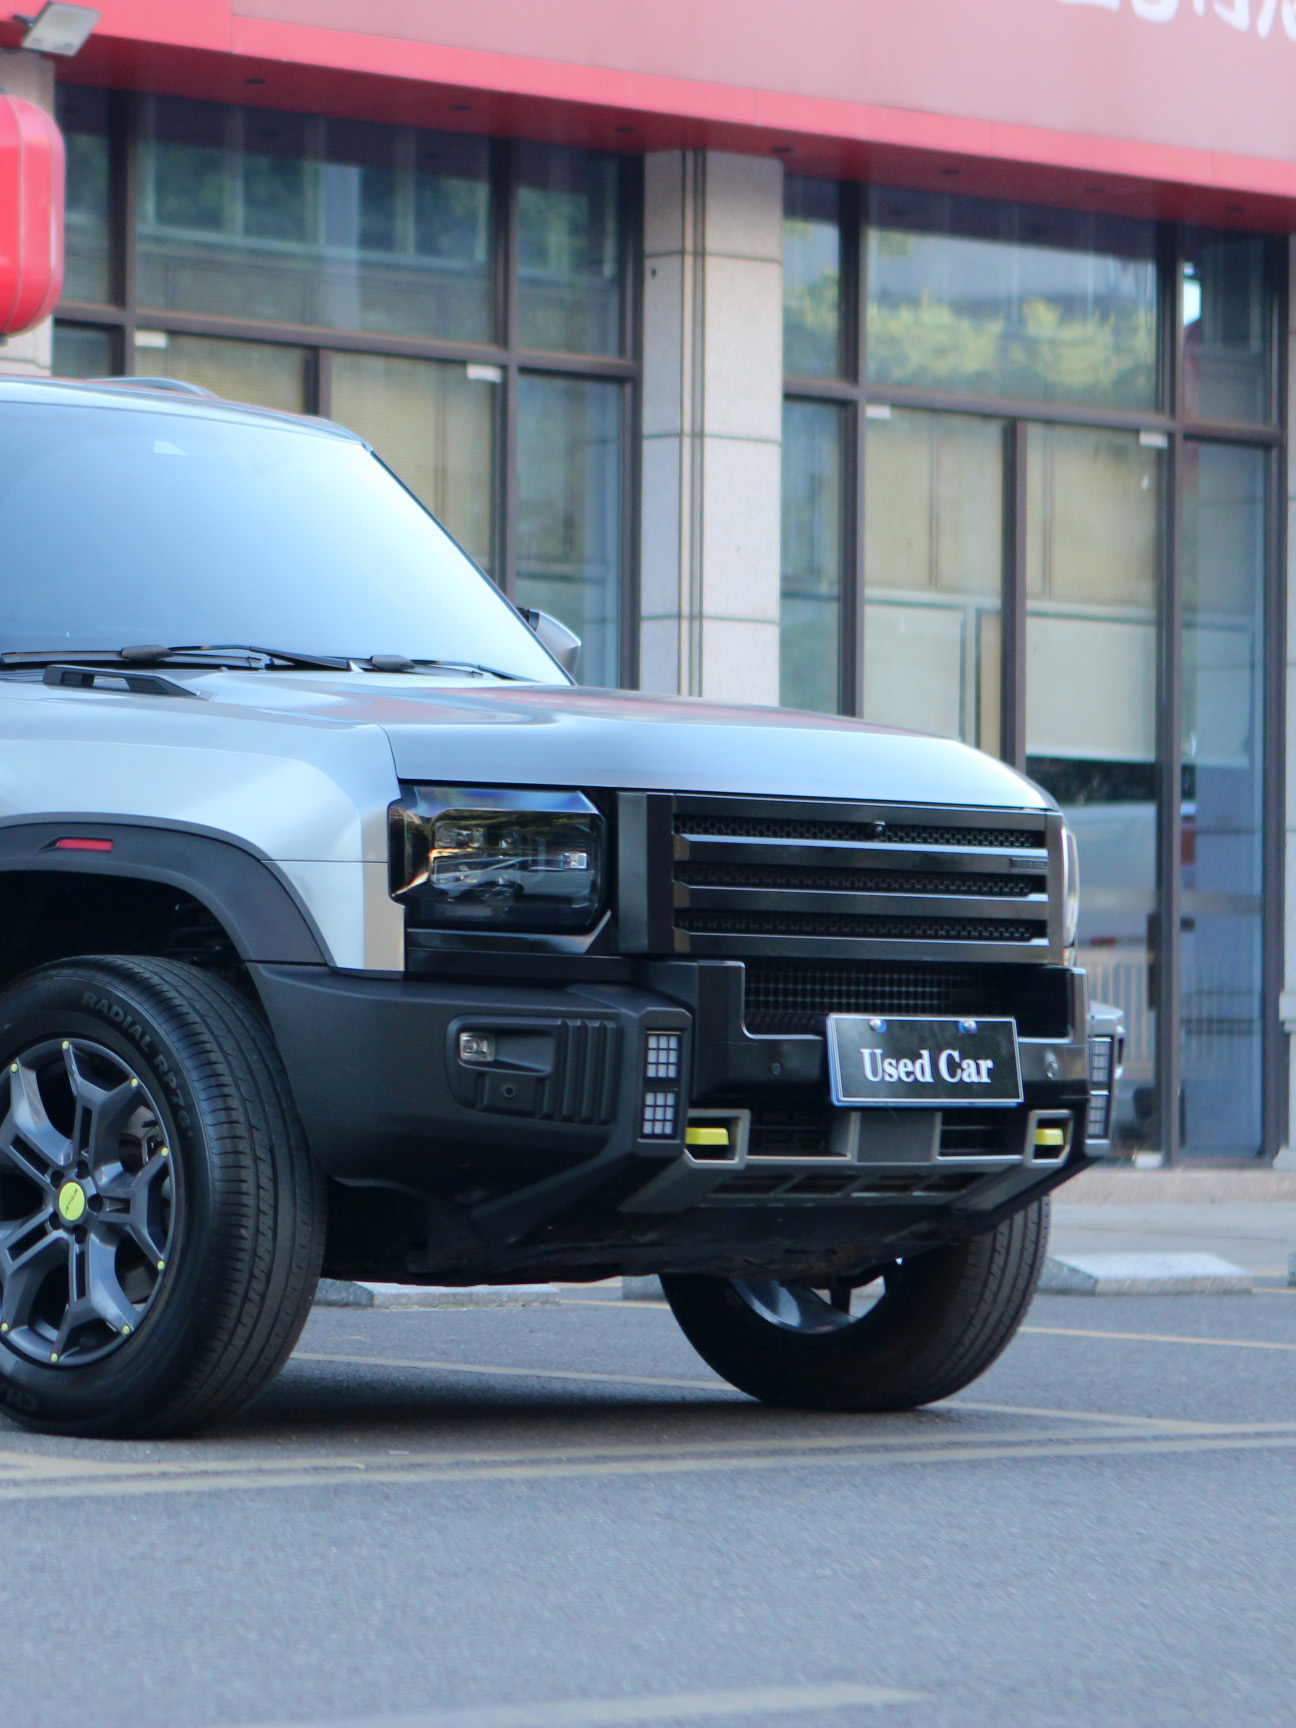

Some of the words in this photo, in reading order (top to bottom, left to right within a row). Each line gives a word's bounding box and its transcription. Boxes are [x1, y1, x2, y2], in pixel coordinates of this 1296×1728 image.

[82, 991, 153, 1054] RADIAL
[860, 1049, 935, 1083] Used
[938, 1049, 994, 1084] Car
